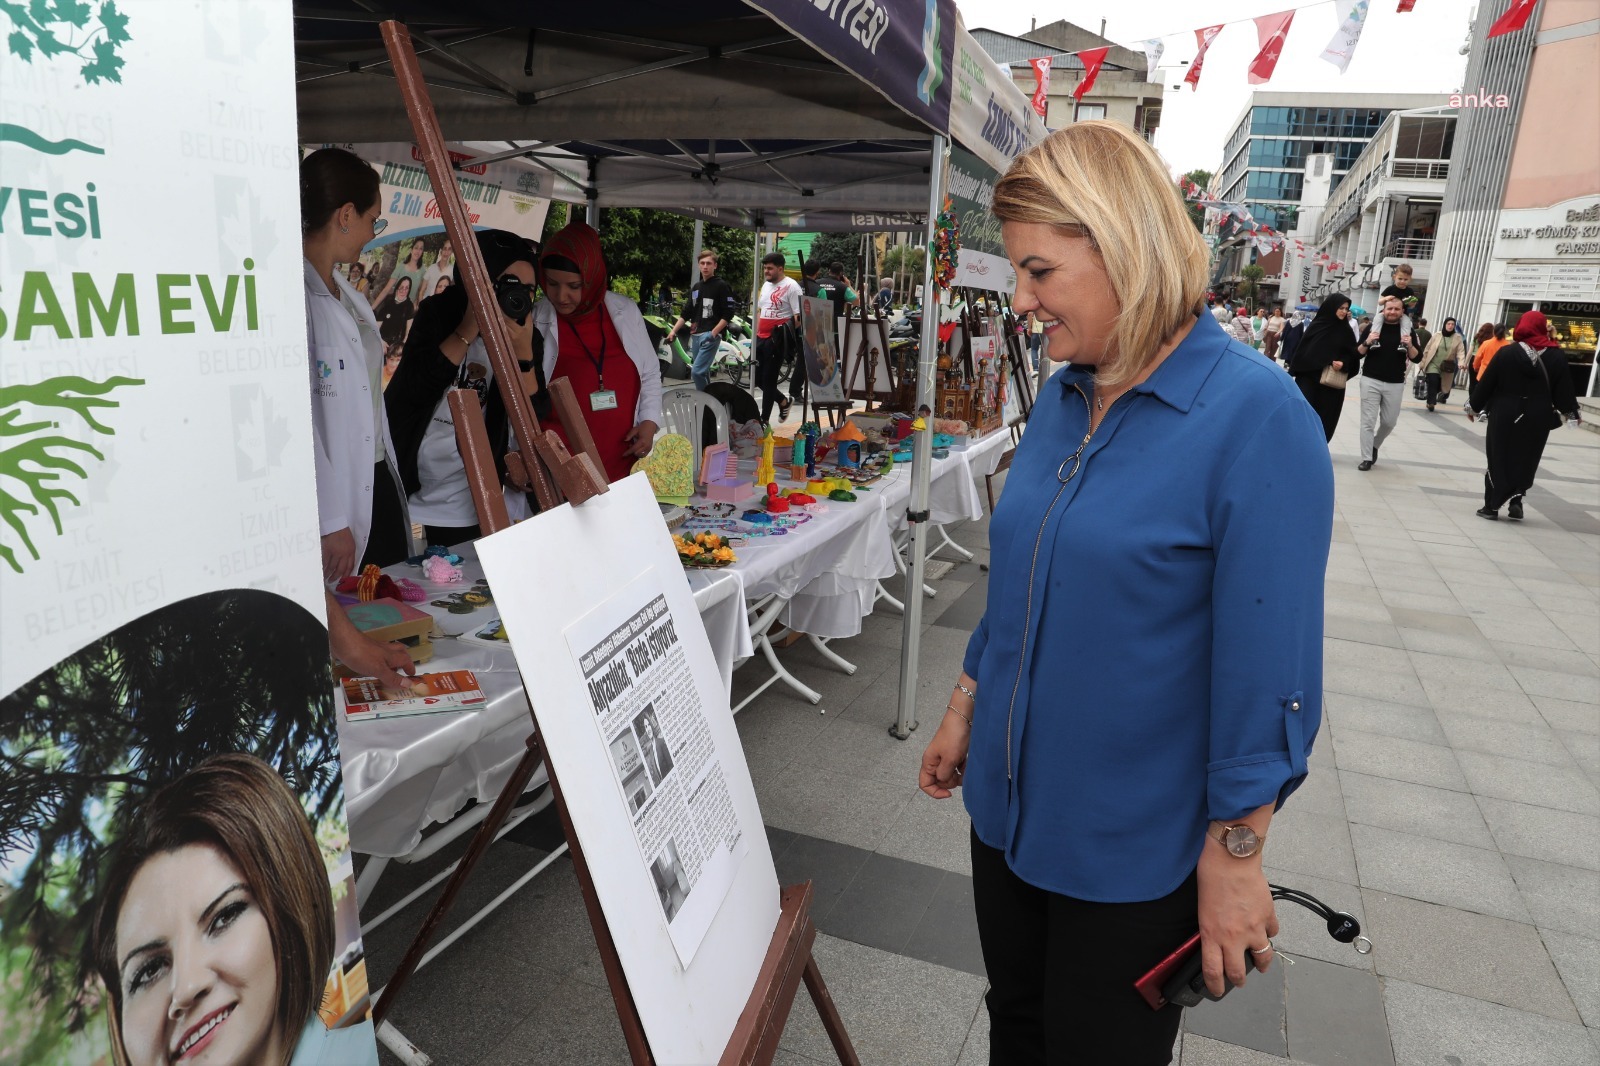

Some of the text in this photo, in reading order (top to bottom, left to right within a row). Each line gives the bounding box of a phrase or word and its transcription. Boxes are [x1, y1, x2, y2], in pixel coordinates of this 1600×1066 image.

[981, 91, 1016, 156] İZMİT
[180, 129, 296, 171] BELEDİYES
[483, 180, 503, 205] EVİ
[1500, 224, 1600, 239] SAAT GÜMÜŞ KU
[156, 257, 259, 335] EVİ
[198, 343, 306, 376] BELEDİYES
[218, 530, 317, 578] BELEDİYES
